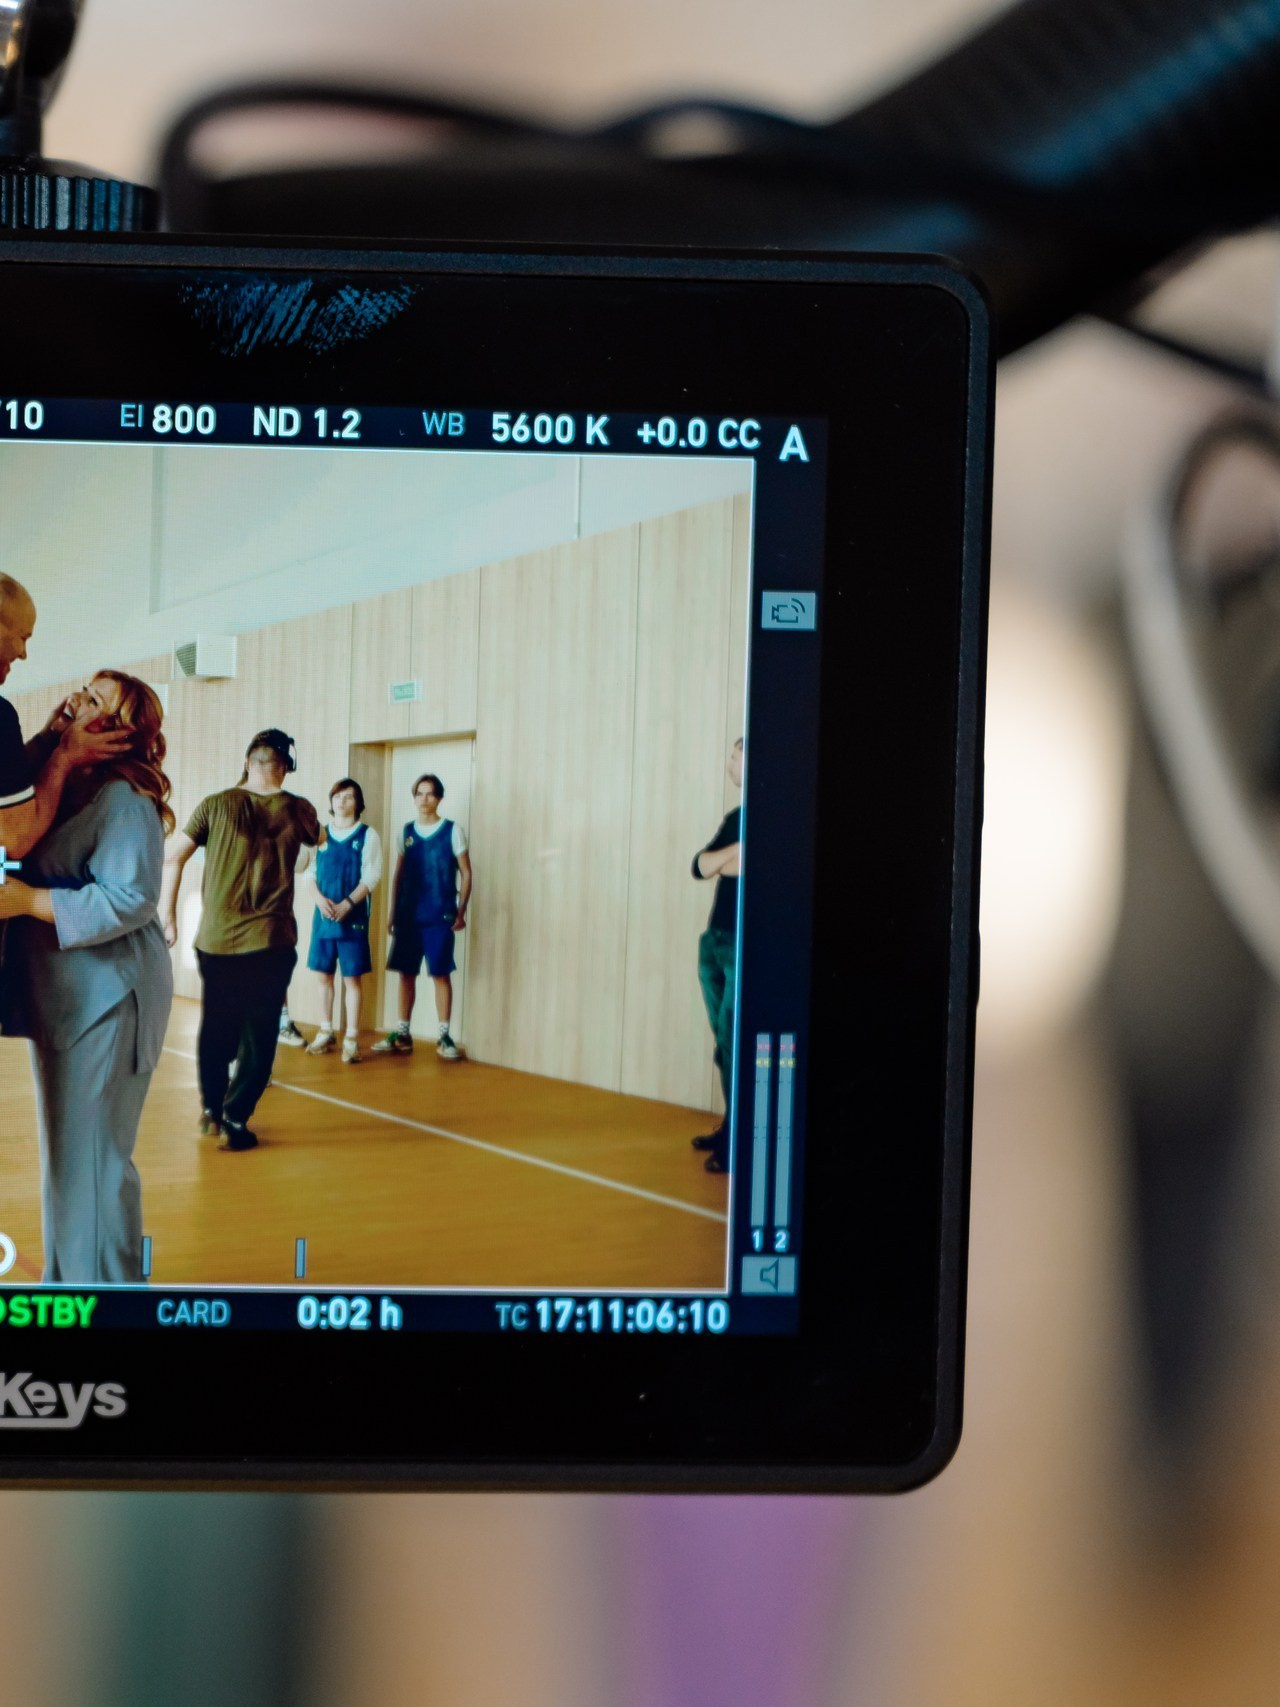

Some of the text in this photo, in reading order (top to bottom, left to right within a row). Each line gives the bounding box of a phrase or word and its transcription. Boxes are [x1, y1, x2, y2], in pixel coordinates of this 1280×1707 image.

[121, 404, 216, 434] EI 800
[253, 408, 361, 439] ND 1.2
[422, 412, 465, 436] WB
[492, 413, 611, 445] 5600 K
[636, 418, 761, 448] +0.0 CC
[779, 425, 809, 461] A
[752, 1230, 787, 1250] 1 2
[7, 1296, 97, 1328] STBY
[156, 1300, 231, 1326] CARD
[298, 1297, 402, 1330] 0:02 h
[496, 1299, 729, 1333] TC 17:11:06:10
